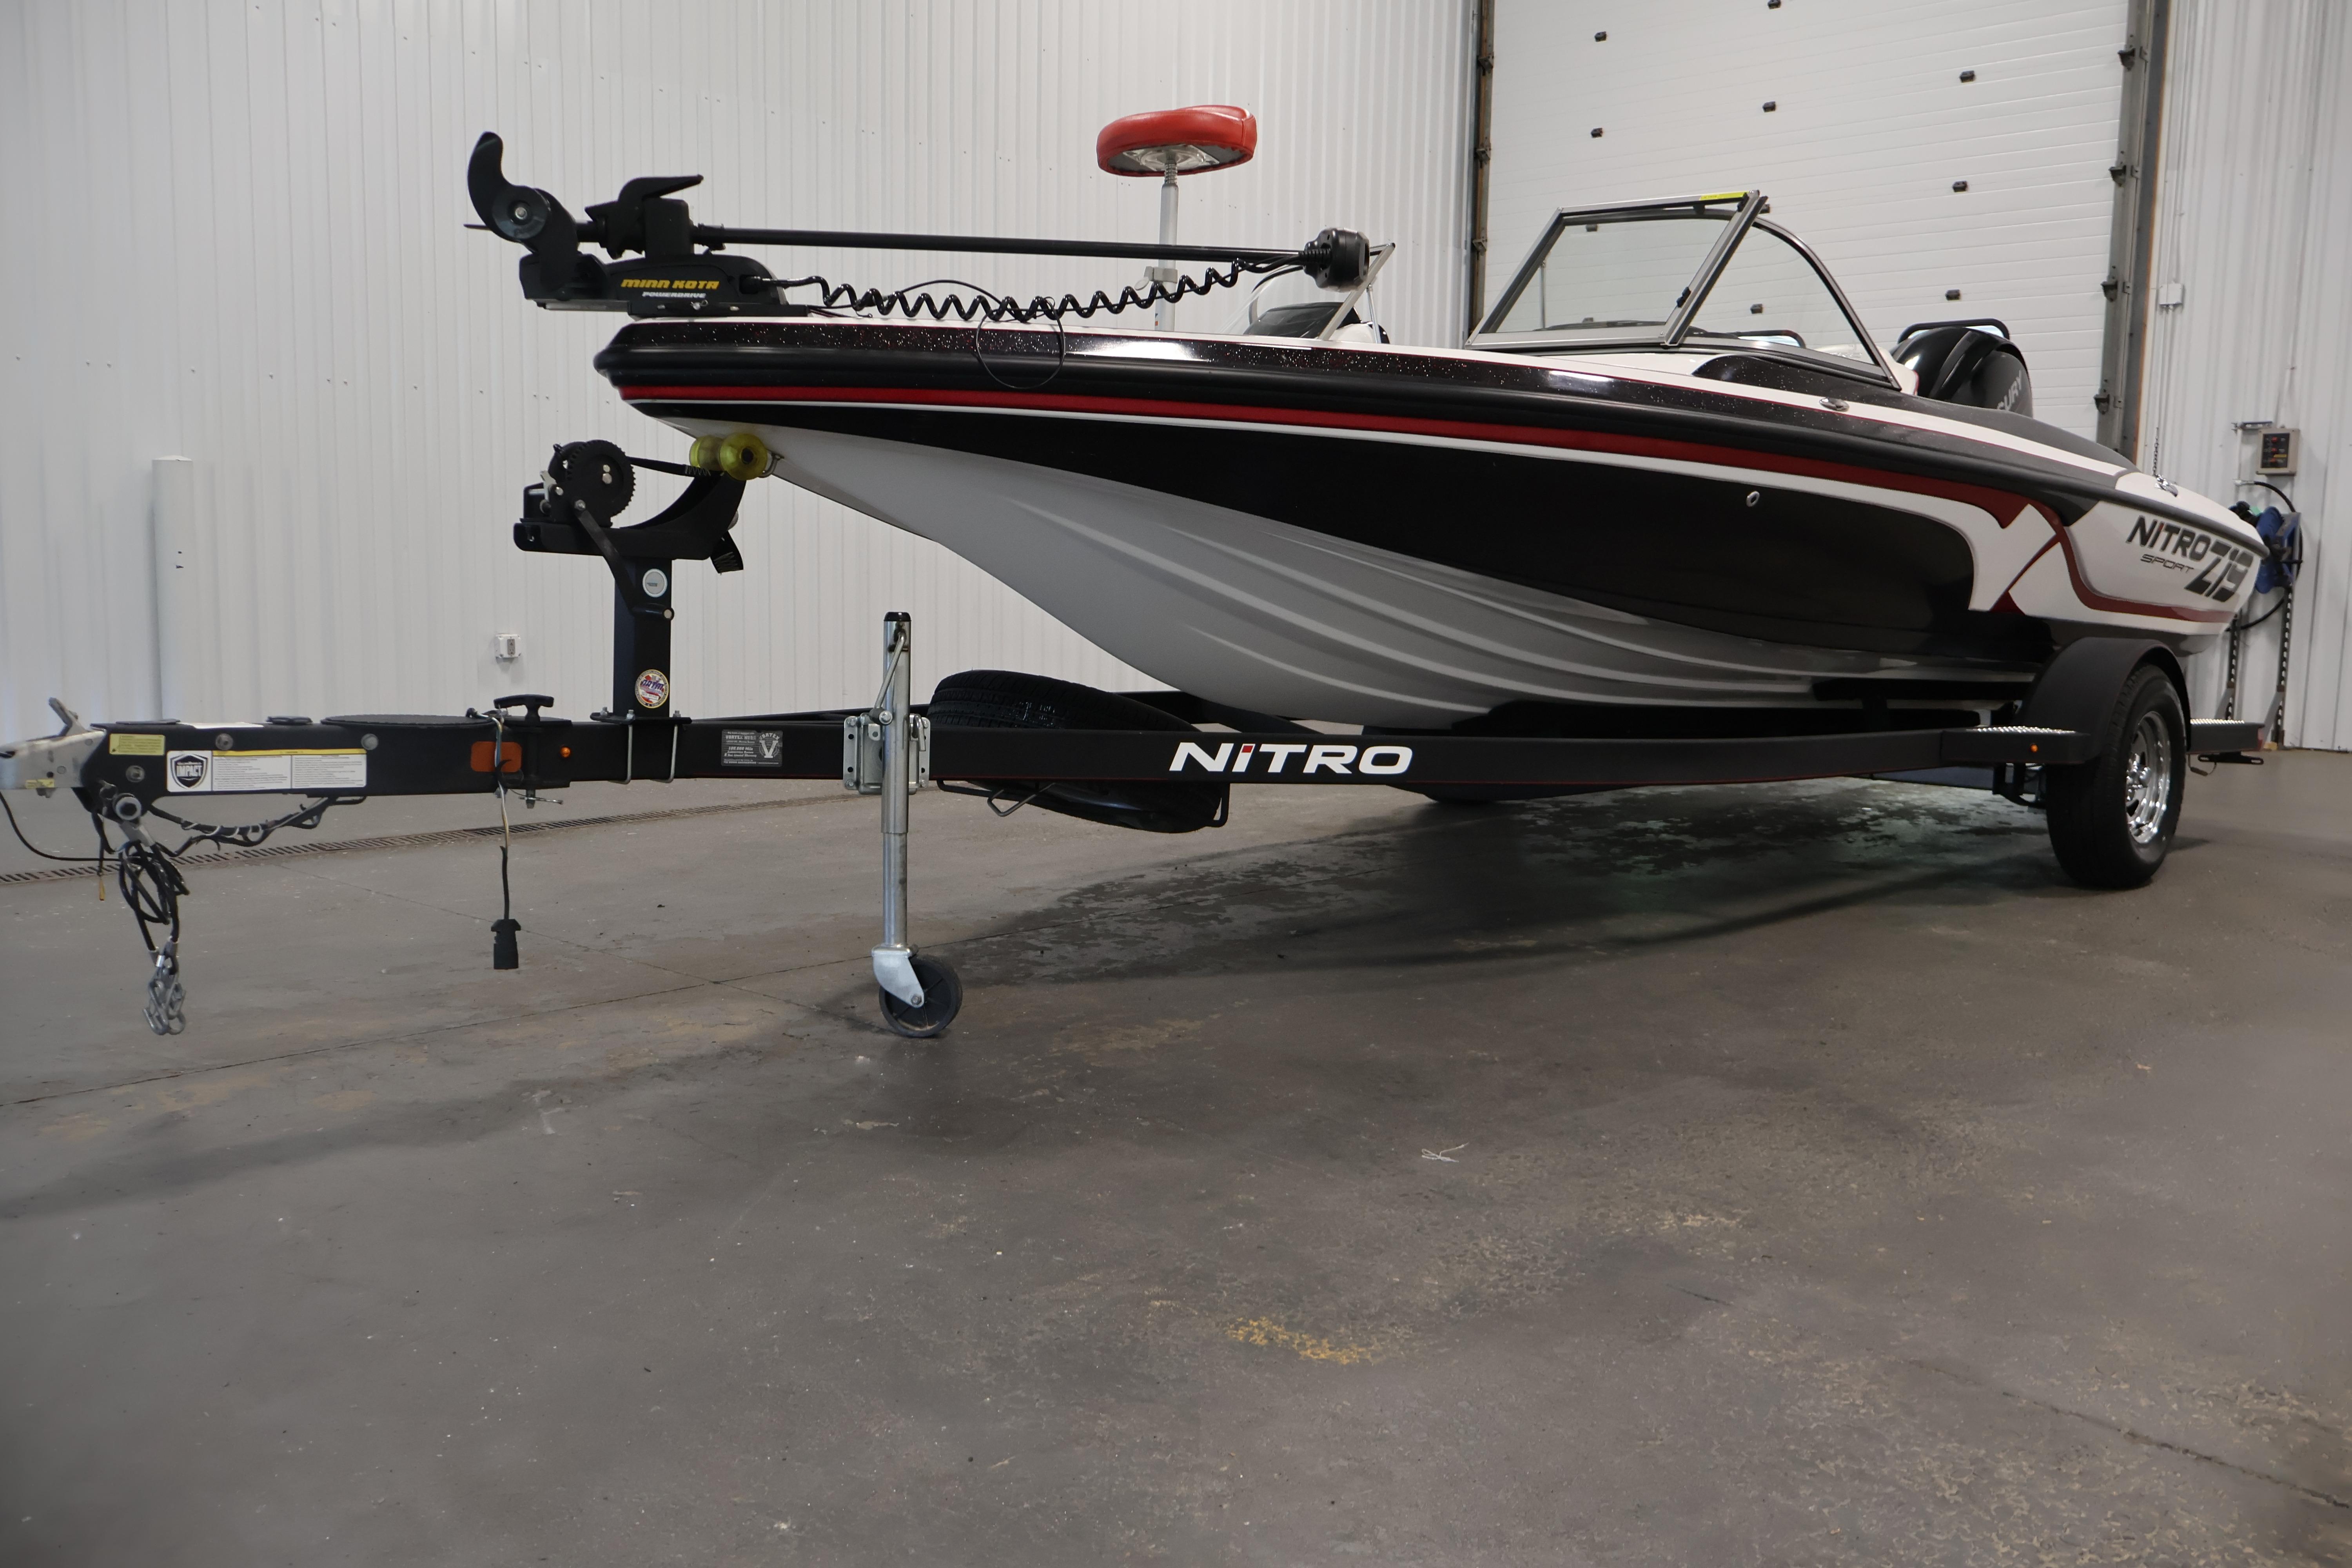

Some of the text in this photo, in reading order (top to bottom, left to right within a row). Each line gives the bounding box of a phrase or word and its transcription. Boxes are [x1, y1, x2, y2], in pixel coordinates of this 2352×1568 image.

[621, 279, 720, 289] MINN KOTA
[2125, 515, 2211, 561] NITRO
[2140, 554, 2194, 573] SPORT
[759, 732, 780, 740] VORTEX
[1169, 742, 1413, 775] NITRO
[176, 765, 202, 777] IMPACT
